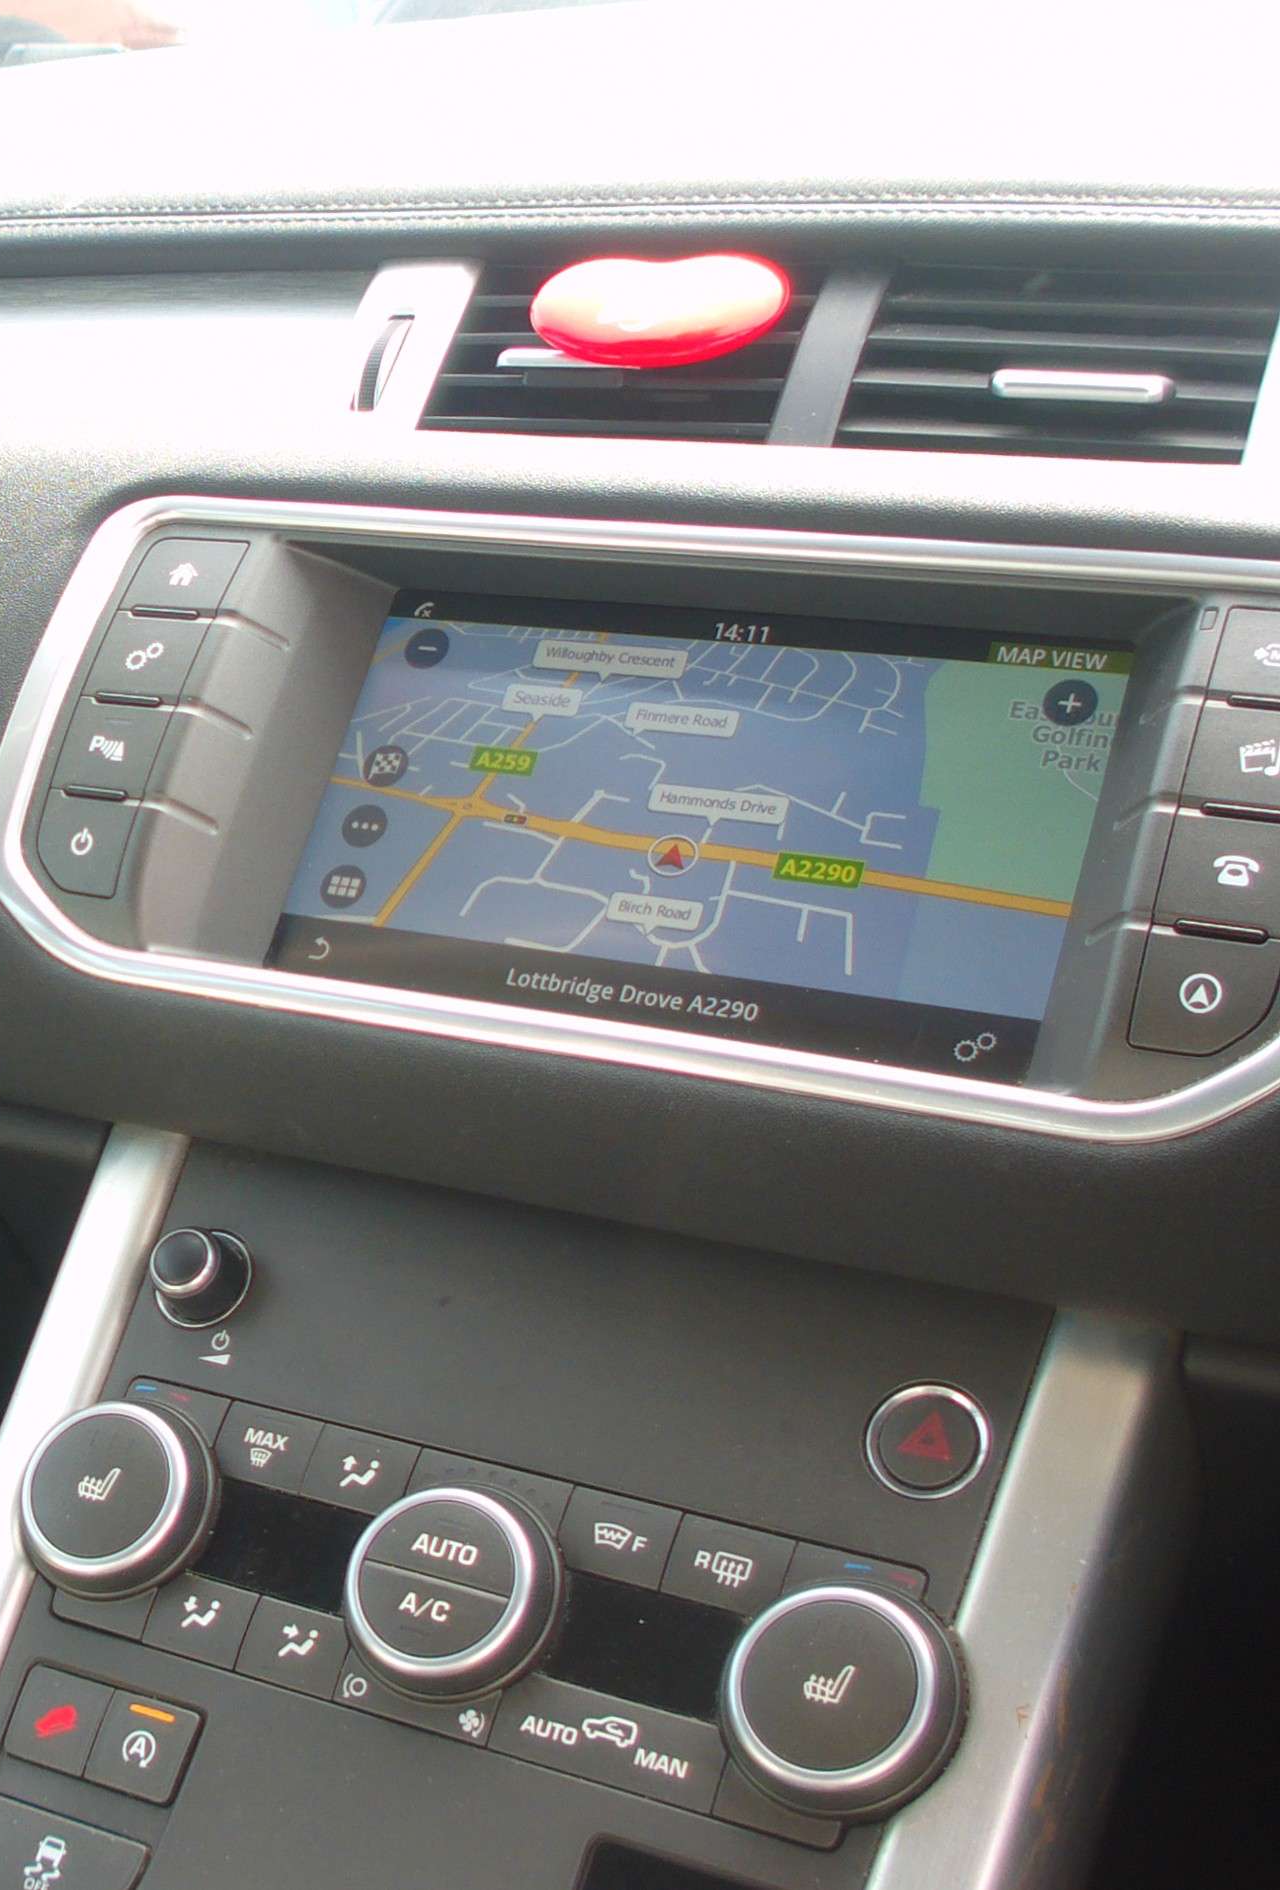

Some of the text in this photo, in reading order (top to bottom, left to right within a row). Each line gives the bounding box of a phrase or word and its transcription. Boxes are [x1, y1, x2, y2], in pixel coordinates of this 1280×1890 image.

[714, 622, 770, 643] 14:11
[545, 647, 675, 668] Willoughby Crescent
[996, 646, 1108, 670] MAP VIEW
[513, 690, 571, 709] Seaside
[635, 709, 728, 729] Finmere Road
[475, 751, 531, 771] A259
[1041, 750, 1100, 771] Park
[660, 791, 777, 815] Hammonds Drive
[779, 859, 857, 883] A2290
[617, 901, 691, 921] Birch Road
[506, 967, 759, 1022] Lottbridge Drove A2290
[243, 1427, 289, 1451] MAX
[410, 1532, 478, 1566] AUTO
[631, 1536, 648, 1552] F
[694, 1550, 711, 1569] R
[398, 1591, 451, 1623] A/C
[520, 1714, 578, 1745] AUTO
[633, 1748, 689, 1779] MAN
